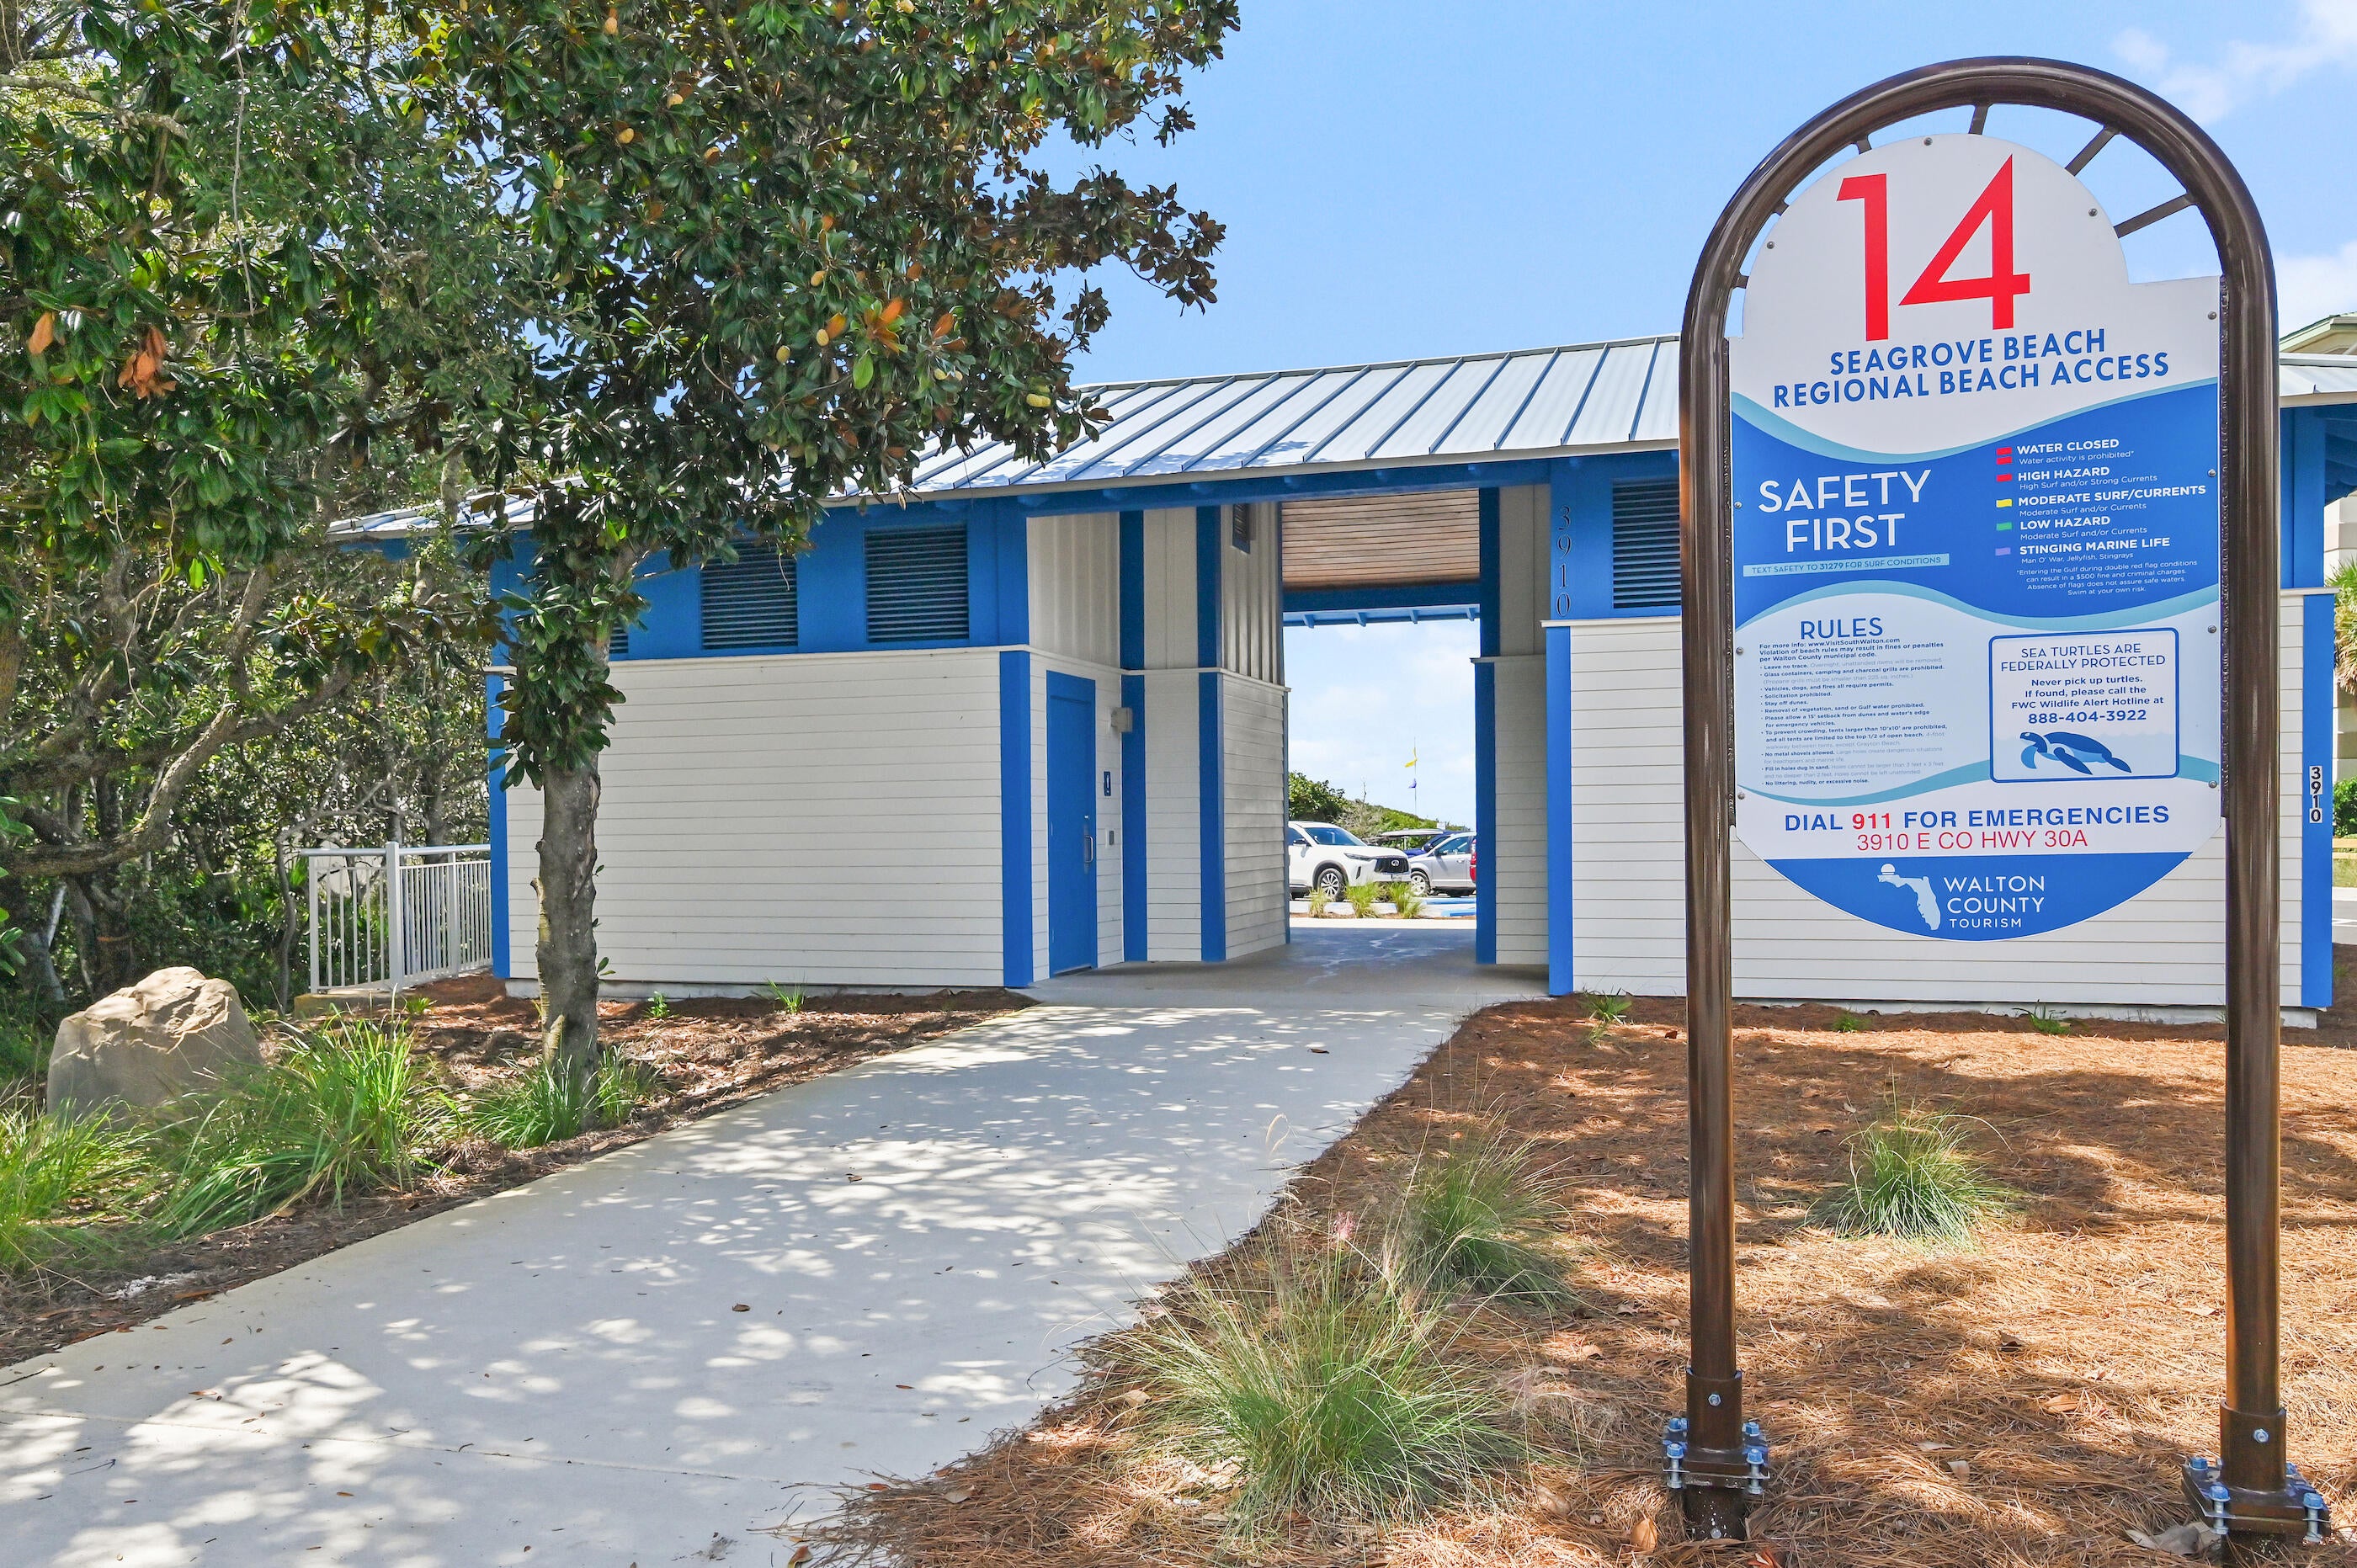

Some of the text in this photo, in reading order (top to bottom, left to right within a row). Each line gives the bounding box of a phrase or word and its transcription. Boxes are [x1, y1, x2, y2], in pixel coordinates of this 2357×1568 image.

[1836, 153, 2030, 341] 14
[1830, 329, 2104, 375] SEAGROVE BEACH
[1774, 352, 2169, 407] REGIONAL BEACH ACCESS
[2017, 439, 2119, 454] WATER CLOSED
[2046, 454, 2076, 463] activity
[2019, 467, 2110, 481] HIGH HAZARD
[2060, 479, 2088, 487] and/or
[2091, 477, 2119, 486] Strong
[2121, 475, 2157, 483] Currents
[1758, 470, 1931, 513] SAFETY
[2019, 486, 2205, 506] MODERATE SURF/CURRENTS
[2019, 508, 2058, 517] Moderate
[2110, 502, 2147, 511] Currents
[2020, 517, 2110, 529] LOW HAZARD
[1787, 513, 1905, 552] FIRST
[2020, 532, 2059, 540] Moderate
[2081, 529, 2109, 537] and/or
[2020, 538, 2170, 555] STINGING MARINE LIFE
[1556, 505, 1572, 617] 3910
[1887, 557, 1940, 566] CONDITIONS
[1801, 618, 1883, 640] RULES
[1808, 638, 1900, 646] www.VisitSouthWalton.com
[2021, 644, 2141, 657] SEA TURTLES ARE
[2002, 656, 2165, 672] FEDERALLY PROTECTED
[2065, 677, 2086, 686] pick
[2035, 688, 2067, 698] found,
[2040, 699, 2079, 708] Wildlife
[2029, 710, 2147, 723] 888-404-3922
[2312, 767, 2321, 821] 3910
[1785, 805, 2169, 831] DIAL 911 FOR EMERGENCIES
[1857, 830, 2088, 851] 3910 E CO HWY 30A
[1944, 875, 2045, 892] WALTON
[1947, 897, 2045, 914] COUNTY
[1950, 918, 2022, 928] TOURISM
